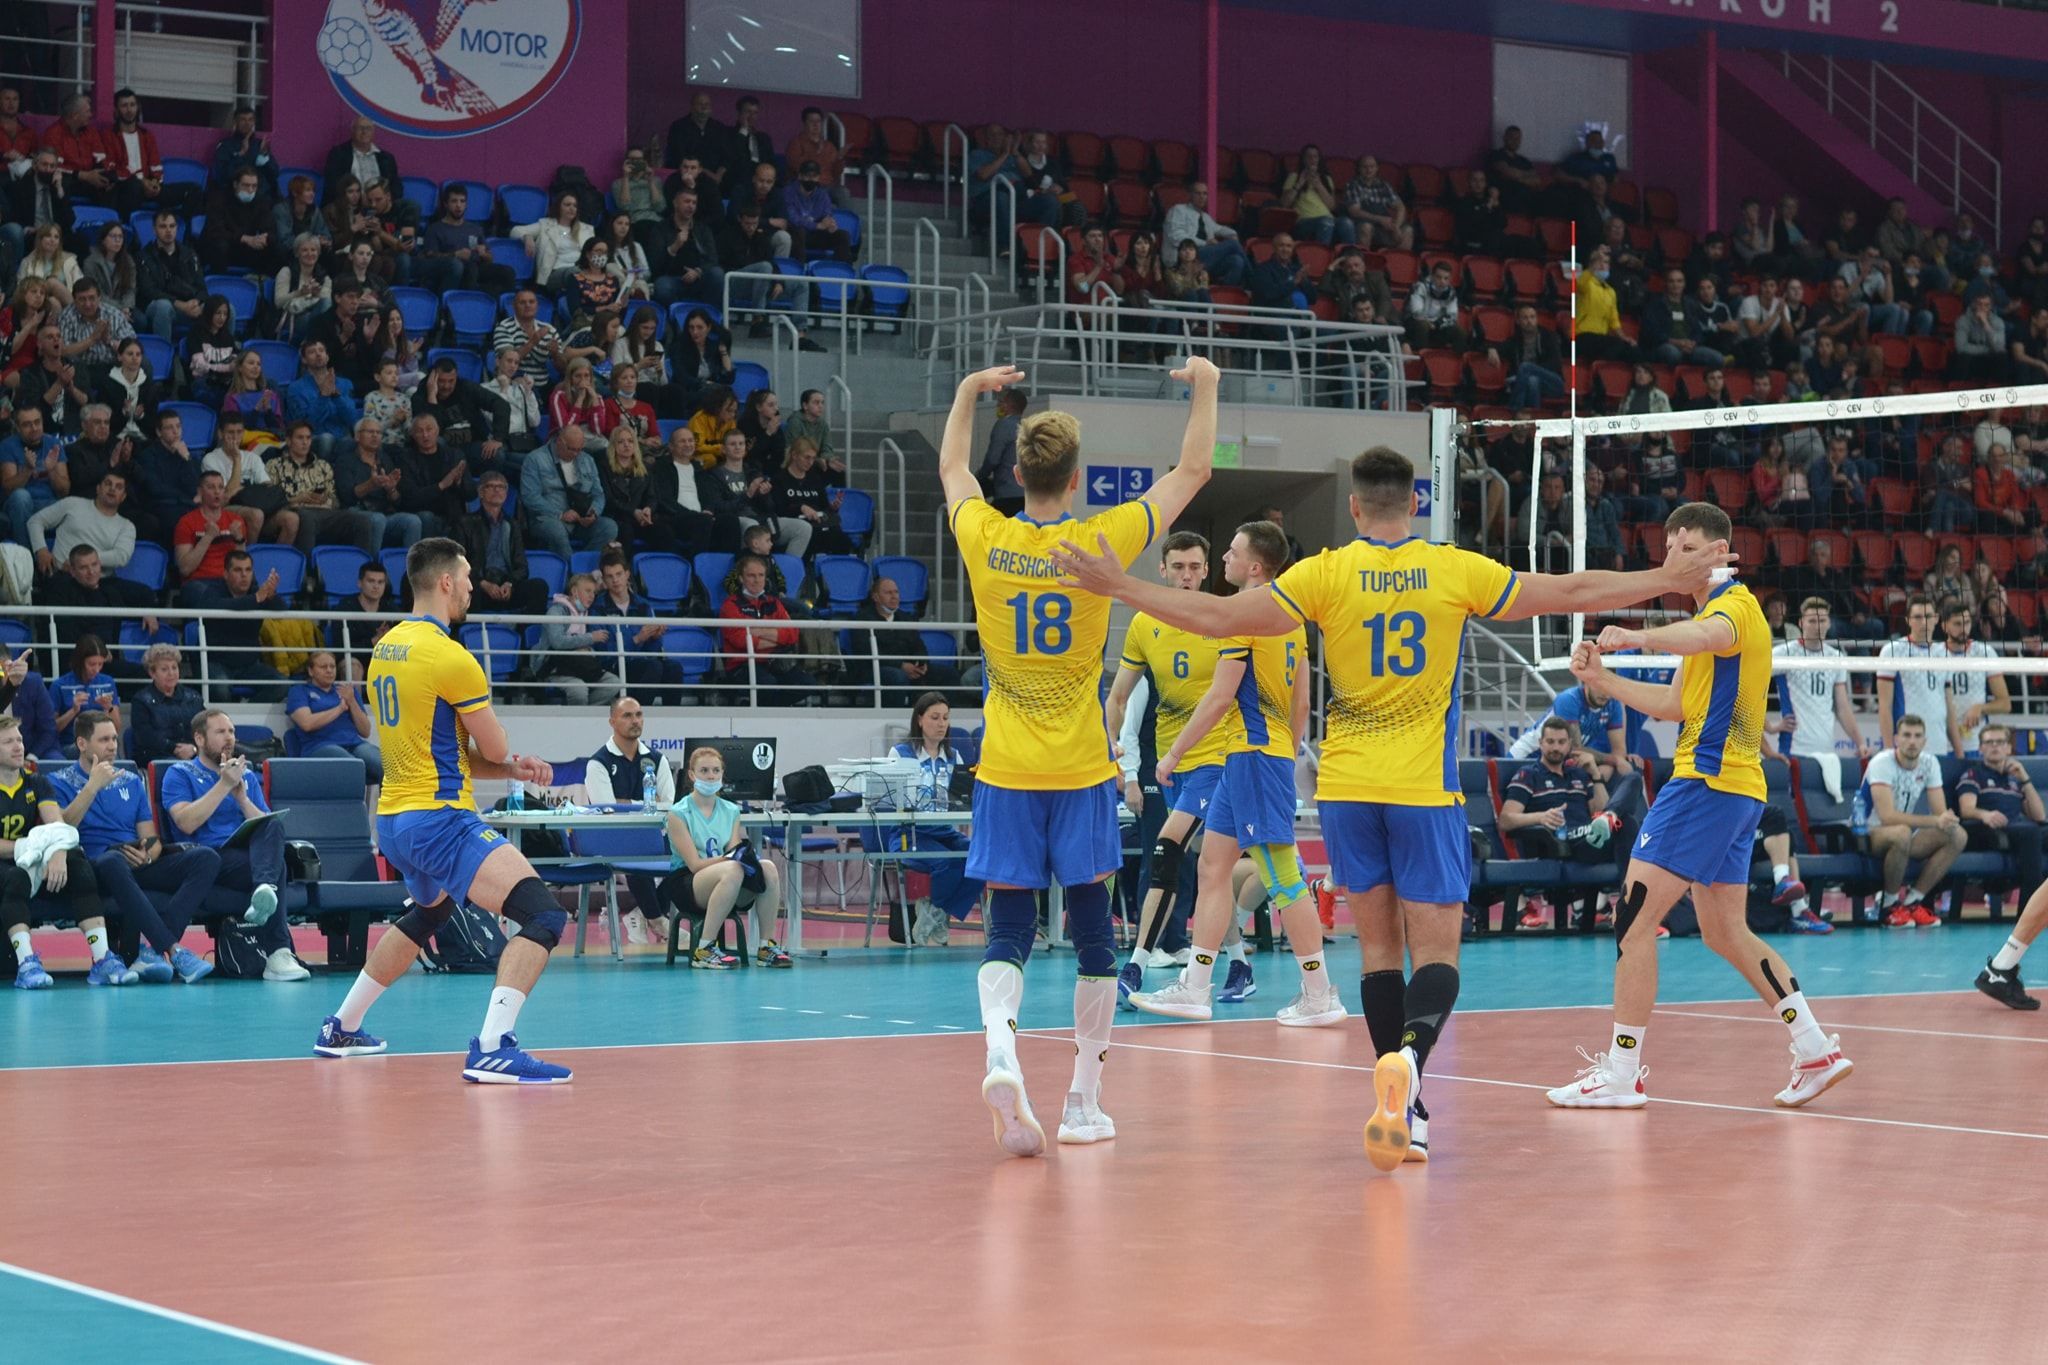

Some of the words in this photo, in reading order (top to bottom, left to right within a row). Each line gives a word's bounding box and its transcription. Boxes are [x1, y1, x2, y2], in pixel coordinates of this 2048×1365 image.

[1880, 1, 1899, 32] 2
[460, 27, 548, 59] MOTOR
[1846, 404, 1862, 413] CEV
[1980, 394, 1996, 403] CEV
[1607, 421, 1621, 429] CEV
[1723, 412, 1738, 421] CEV
[1130, 469, 1143, 490] 3
[1358, 568, 1428, 593] TUPCHII
[1006, 591, 1072, 655] 18
[1362, 610, 1426, 677] 13
[1173, 651, 1189, 679] 6
[1810, 672, 1826, 696] 16
[1952, 671, 1969, 695] 19
[372, 675, 400, 727] 10
[1, 814, 25, 840] 12
[480, 829, 499, 842] 10
[706, 837, 721, 858] 6
[1197, 955, 1212, 964] VS
[1303, 962, 1319, 970] VS
[1781, 1009, 1796, 1022] VS
[1618, 1036, 1635, 1047] VS
